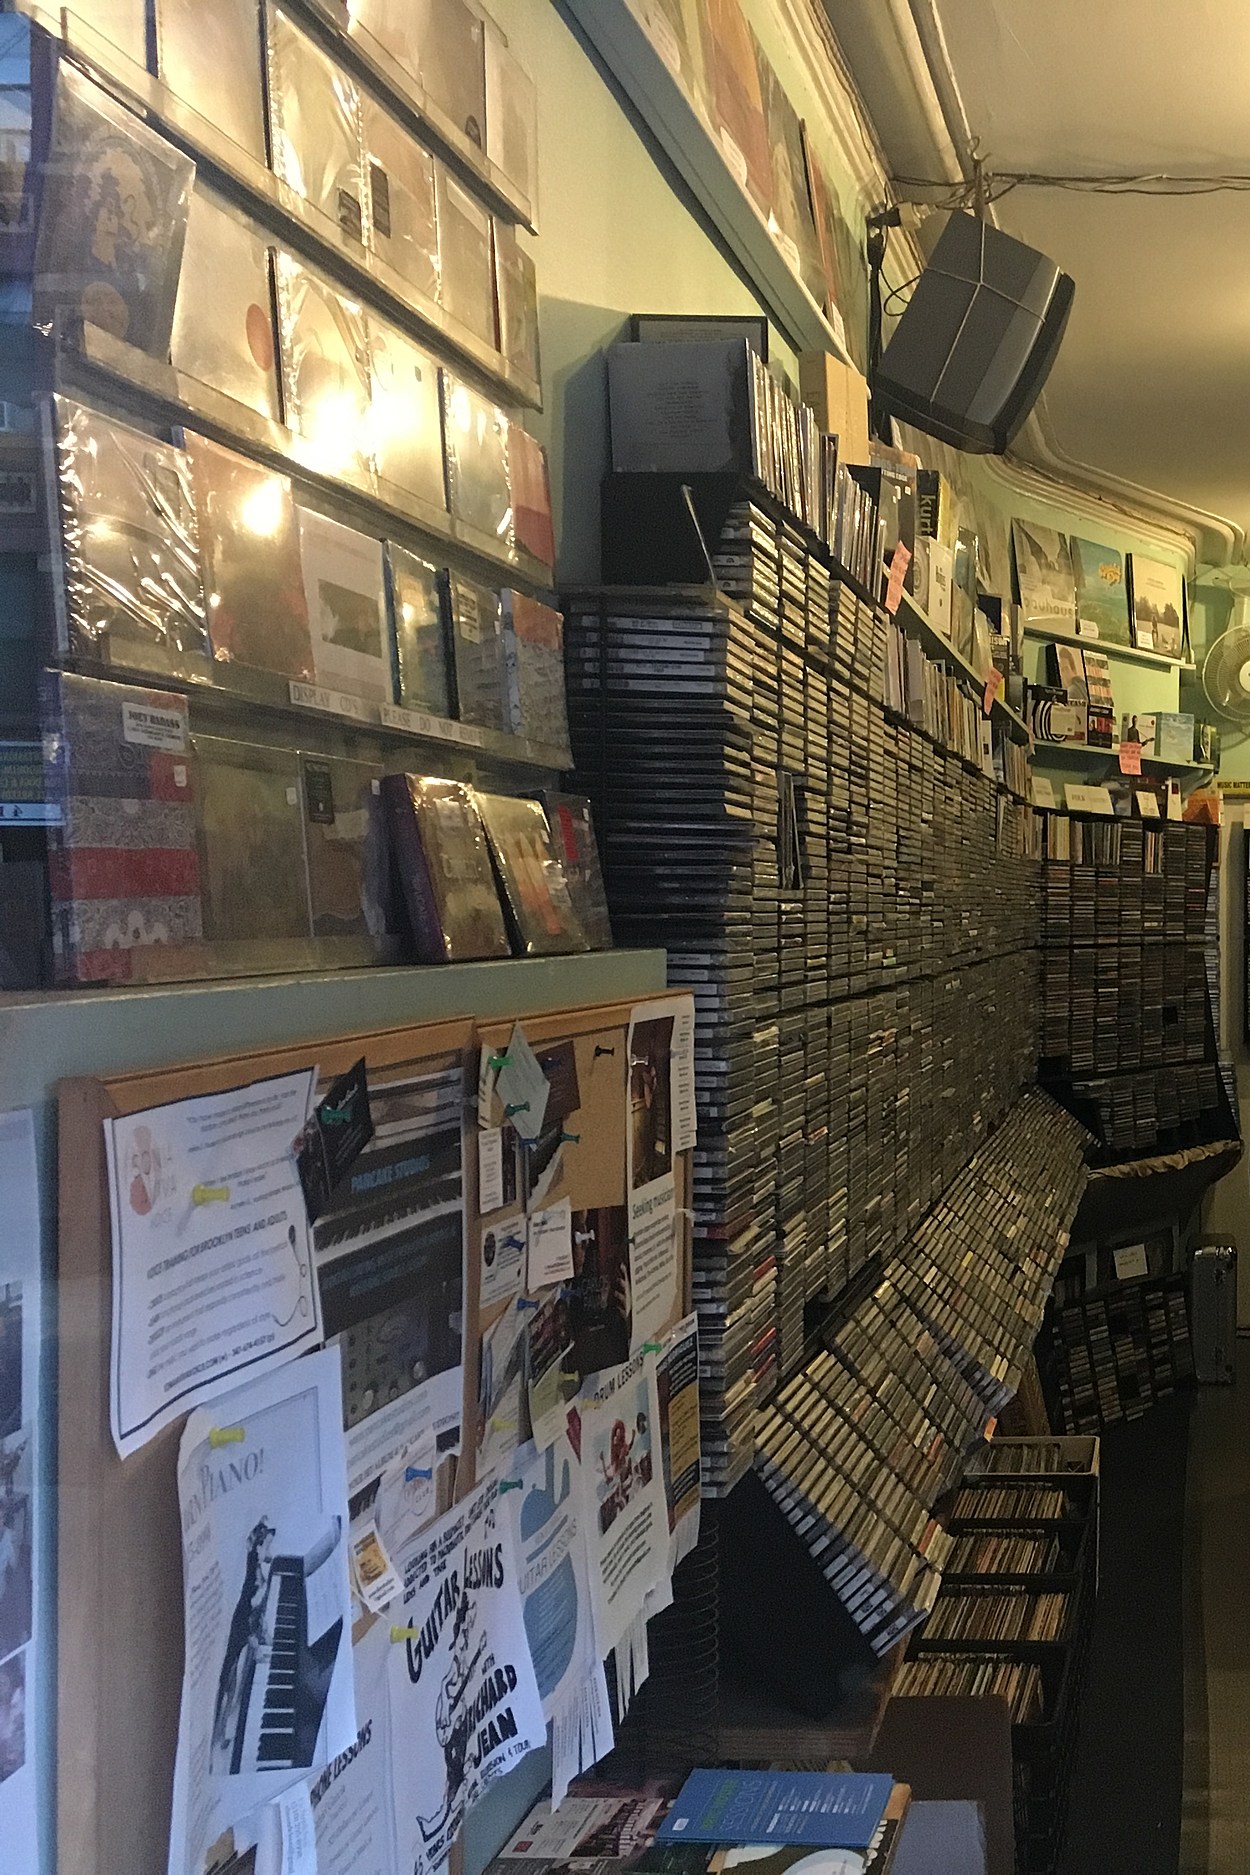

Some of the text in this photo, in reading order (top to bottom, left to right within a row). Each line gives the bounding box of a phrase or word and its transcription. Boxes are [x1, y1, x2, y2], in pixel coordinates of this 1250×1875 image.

[920, 493, 937, 537] kurt
[1218, 781, 1233, 789] MUSIC
[200, 1447, 265, 1507] PIANO!
[405, 1570, 462, 1684] GUITAR
[463, 1542, 505, 1591] LESSONS
[466, 1664, 518, 1735] RICHARD
[473, 1706, 519, 1770] JEAN
